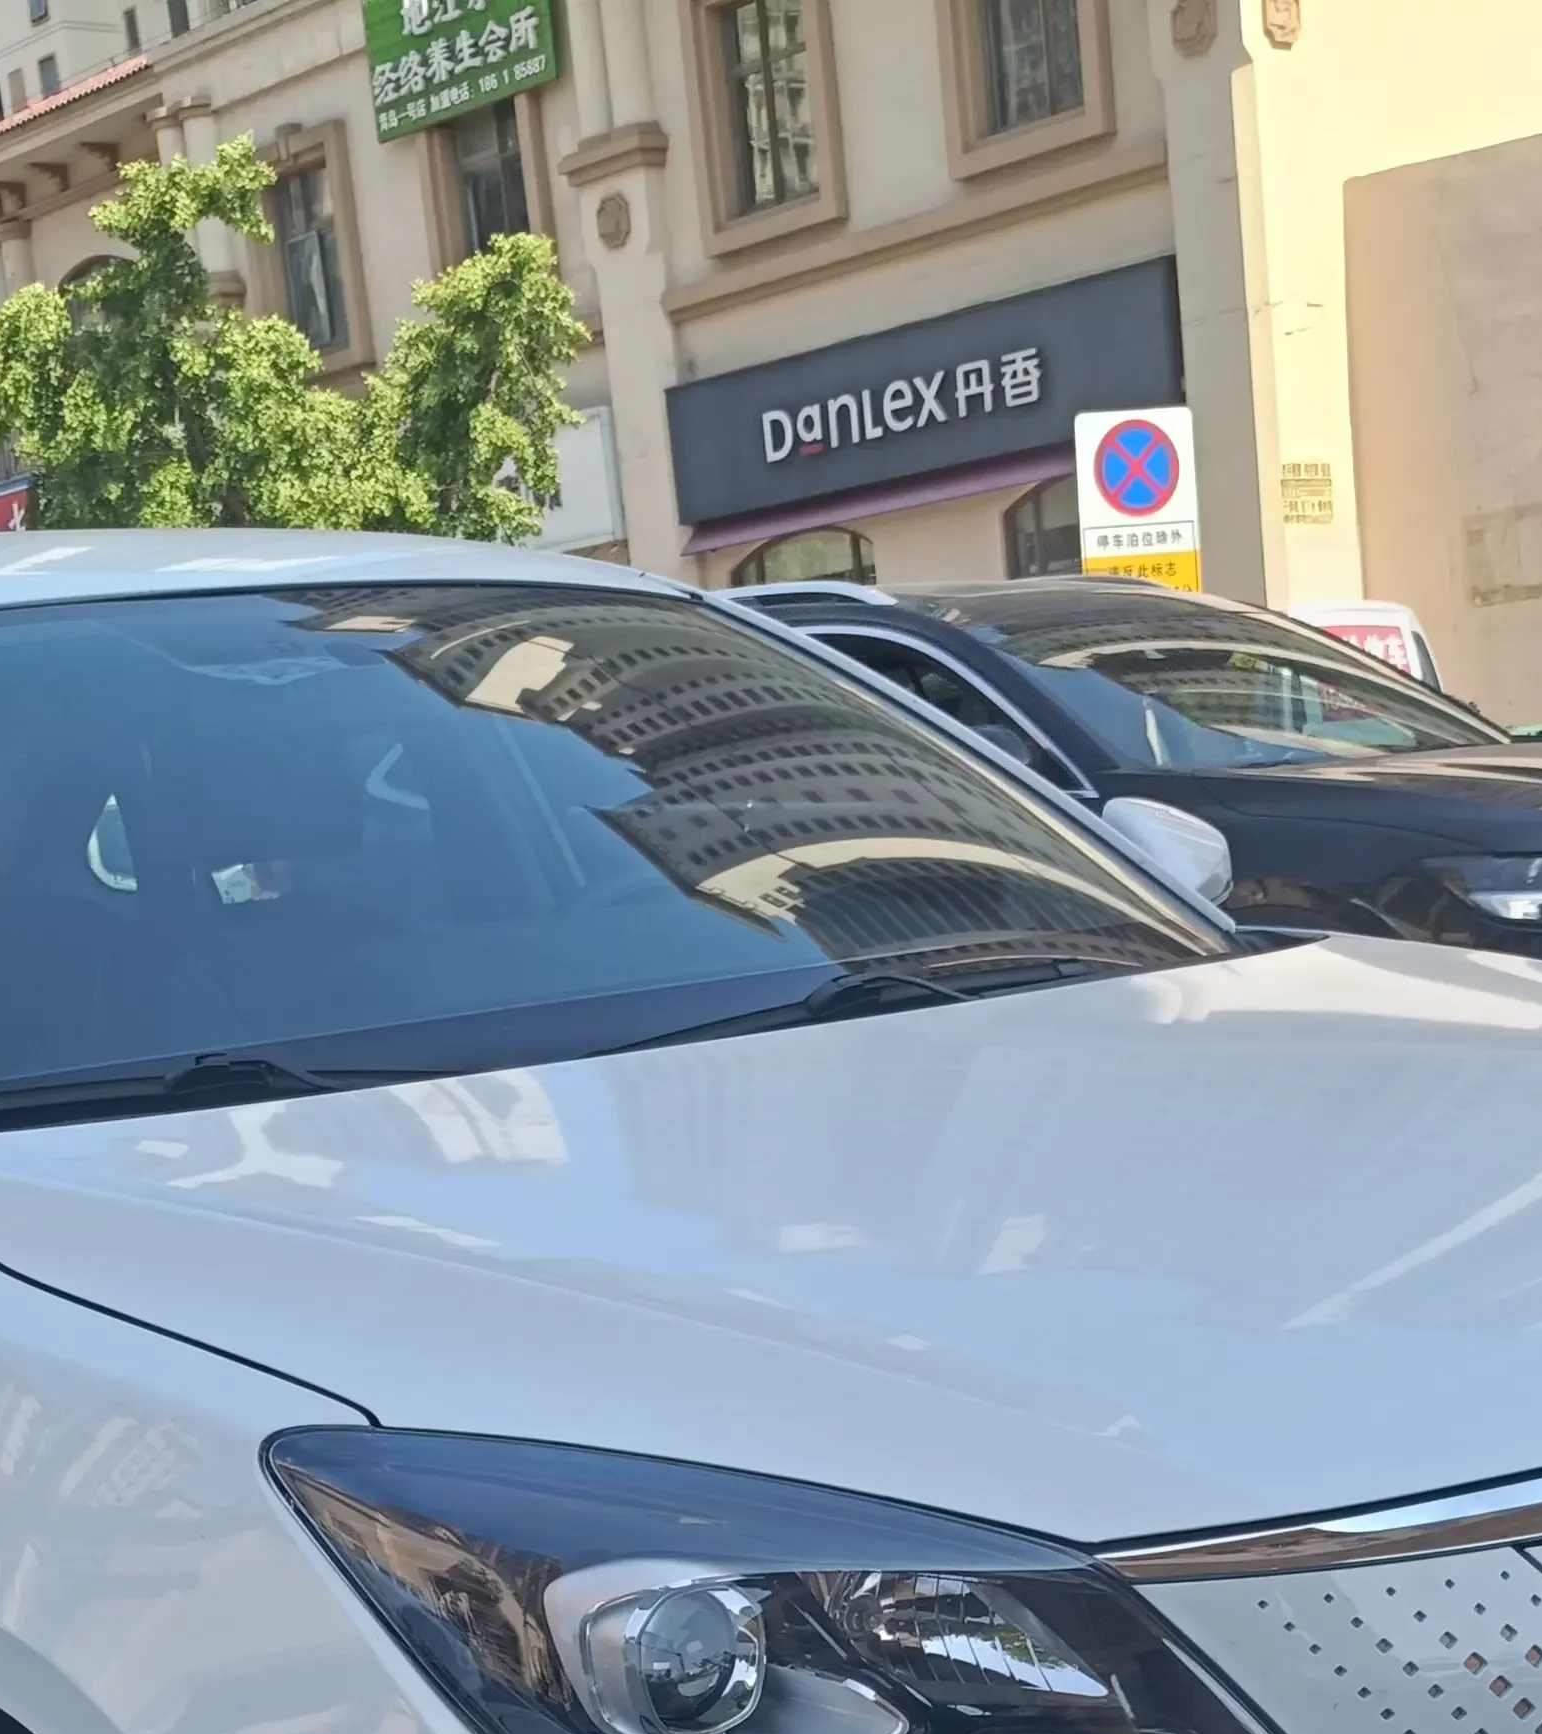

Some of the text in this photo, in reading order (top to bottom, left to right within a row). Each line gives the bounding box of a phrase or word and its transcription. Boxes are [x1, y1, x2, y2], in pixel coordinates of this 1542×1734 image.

[373, 6, 540, 106] 经络养生会所
[955, 348, 1043, 418] 丹香
